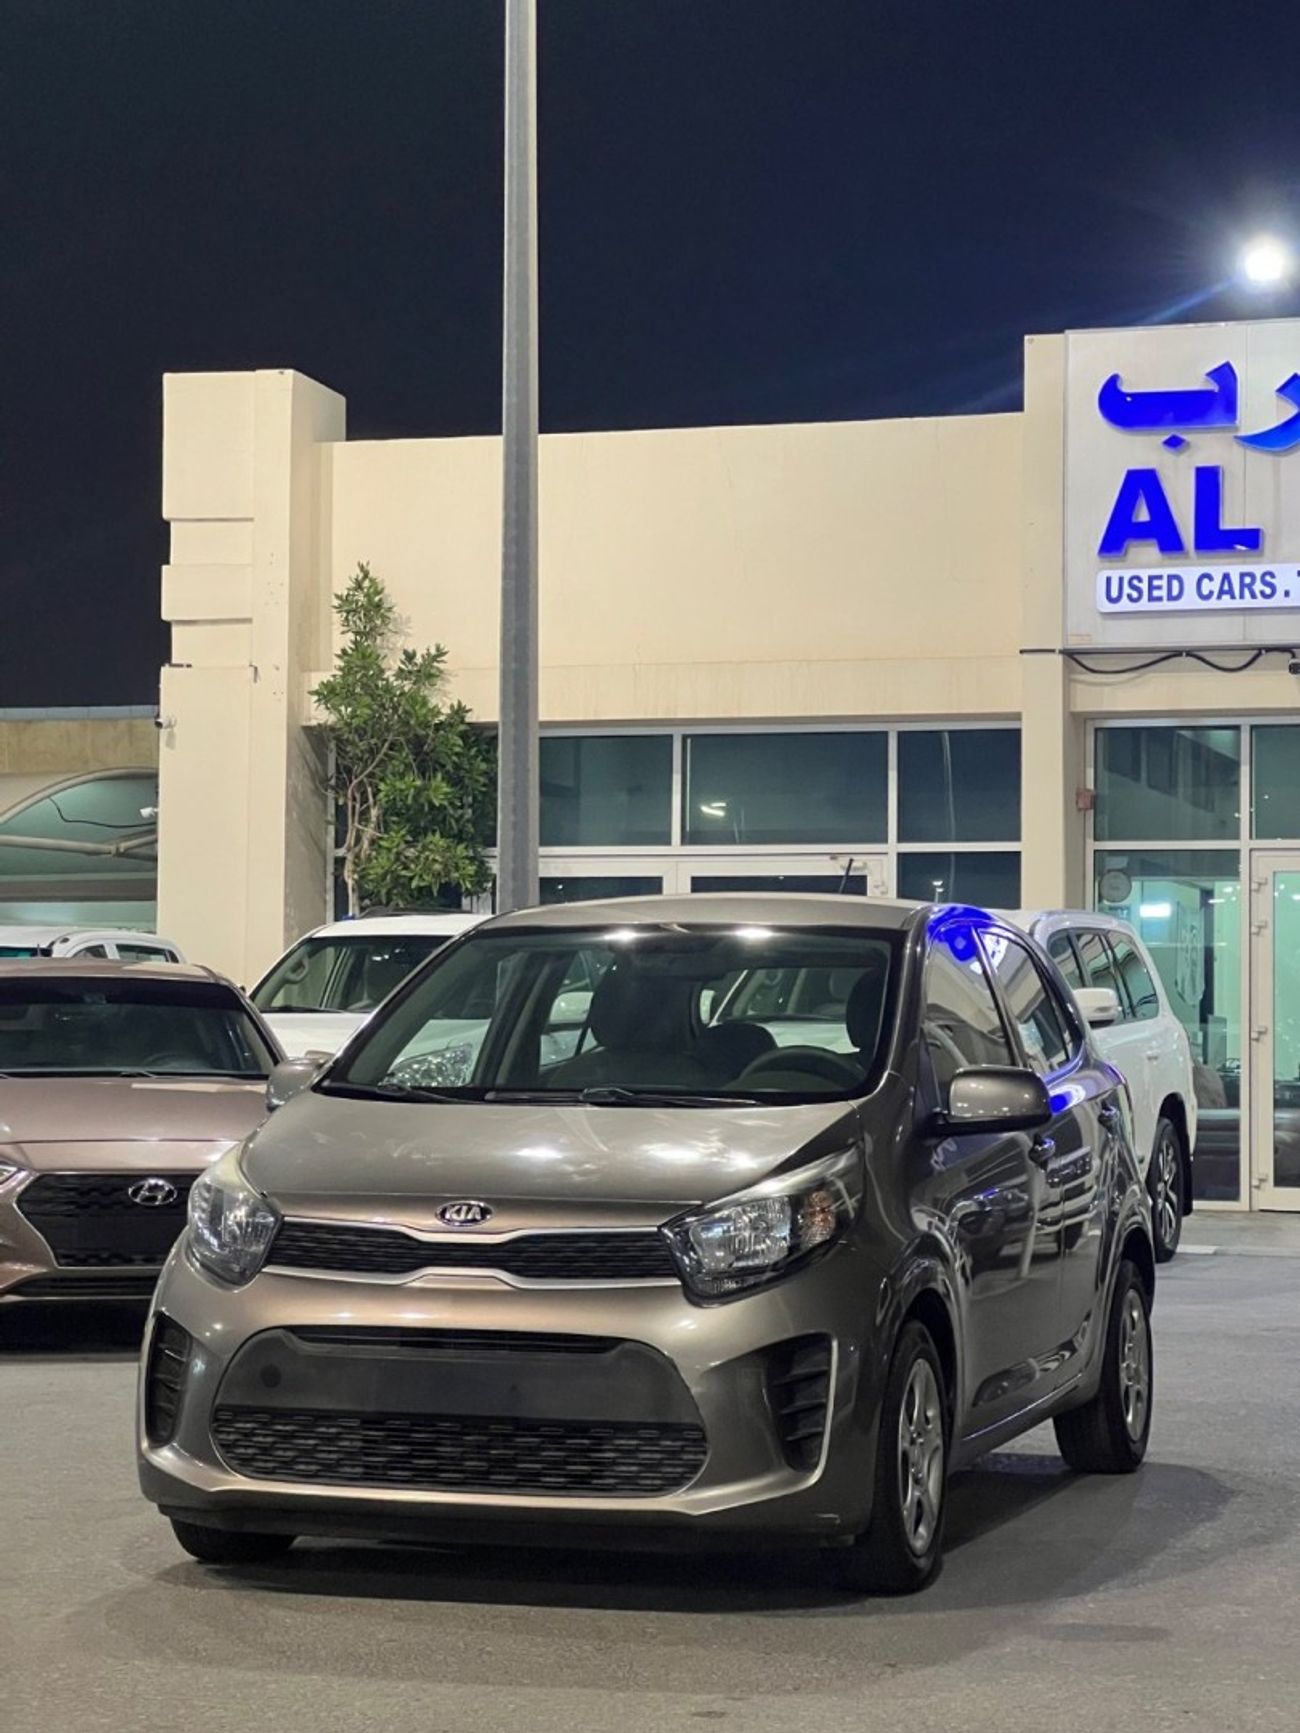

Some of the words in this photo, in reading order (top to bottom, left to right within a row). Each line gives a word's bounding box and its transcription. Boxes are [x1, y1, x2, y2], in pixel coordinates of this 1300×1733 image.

[1098, 465, 1261, 555] AL
[1105, 574, 1184, 604] USED
[444, 1205, 482, 1221] KIA
